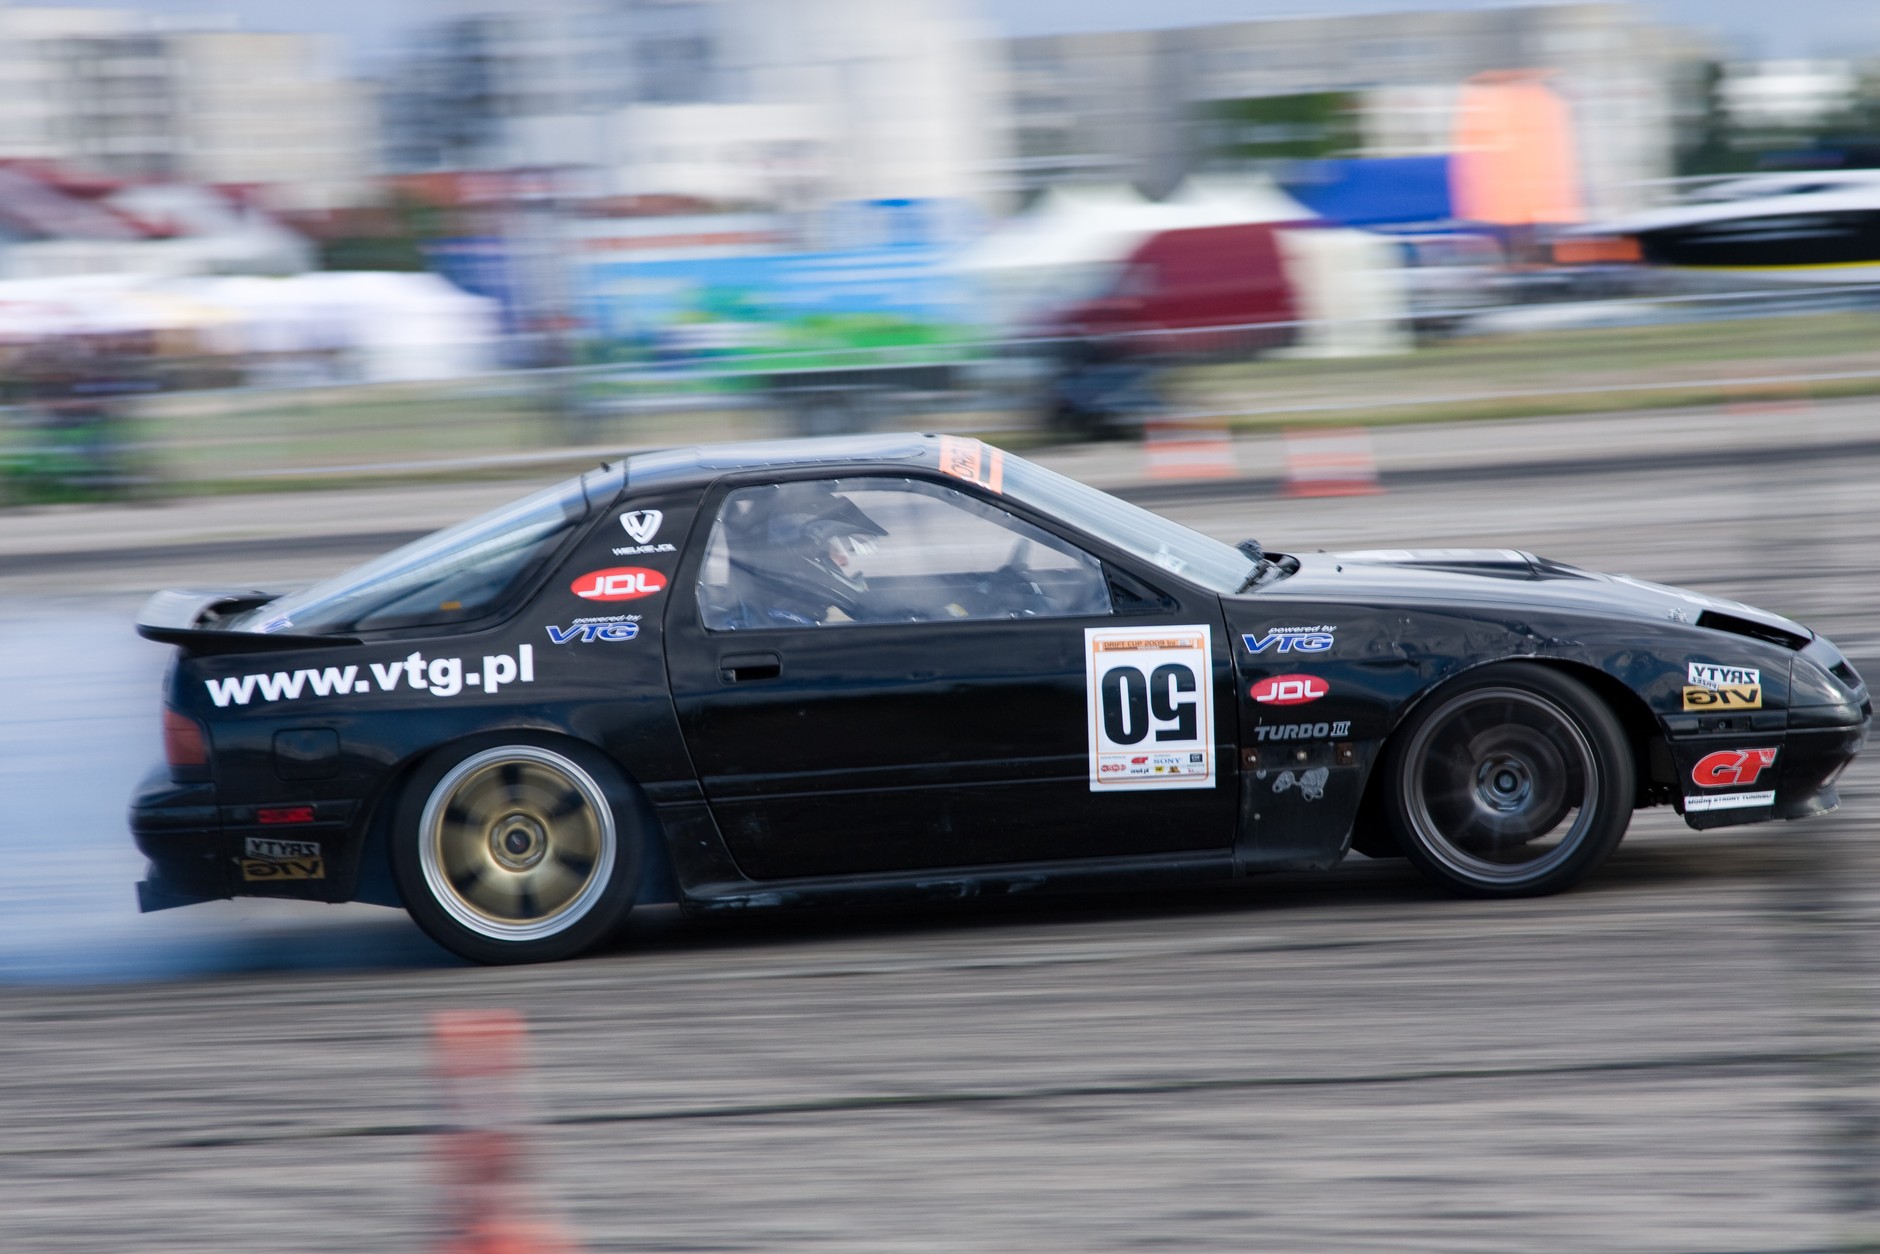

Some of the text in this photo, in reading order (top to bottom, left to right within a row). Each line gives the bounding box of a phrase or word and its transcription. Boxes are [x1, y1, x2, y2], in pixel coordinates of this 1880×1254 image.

[545, 621, 640, 644] VTG
[1268, 624, 1338, 633] powered by
[1241, 633, 1334, 653] VTG
[204, 643, 534, 707] www.vtg.pl
[1256, 679, 1325, 702] JDL
[1254, 722, 1329, 741] TURBO
[1692, 748, 1777, 788] GT
